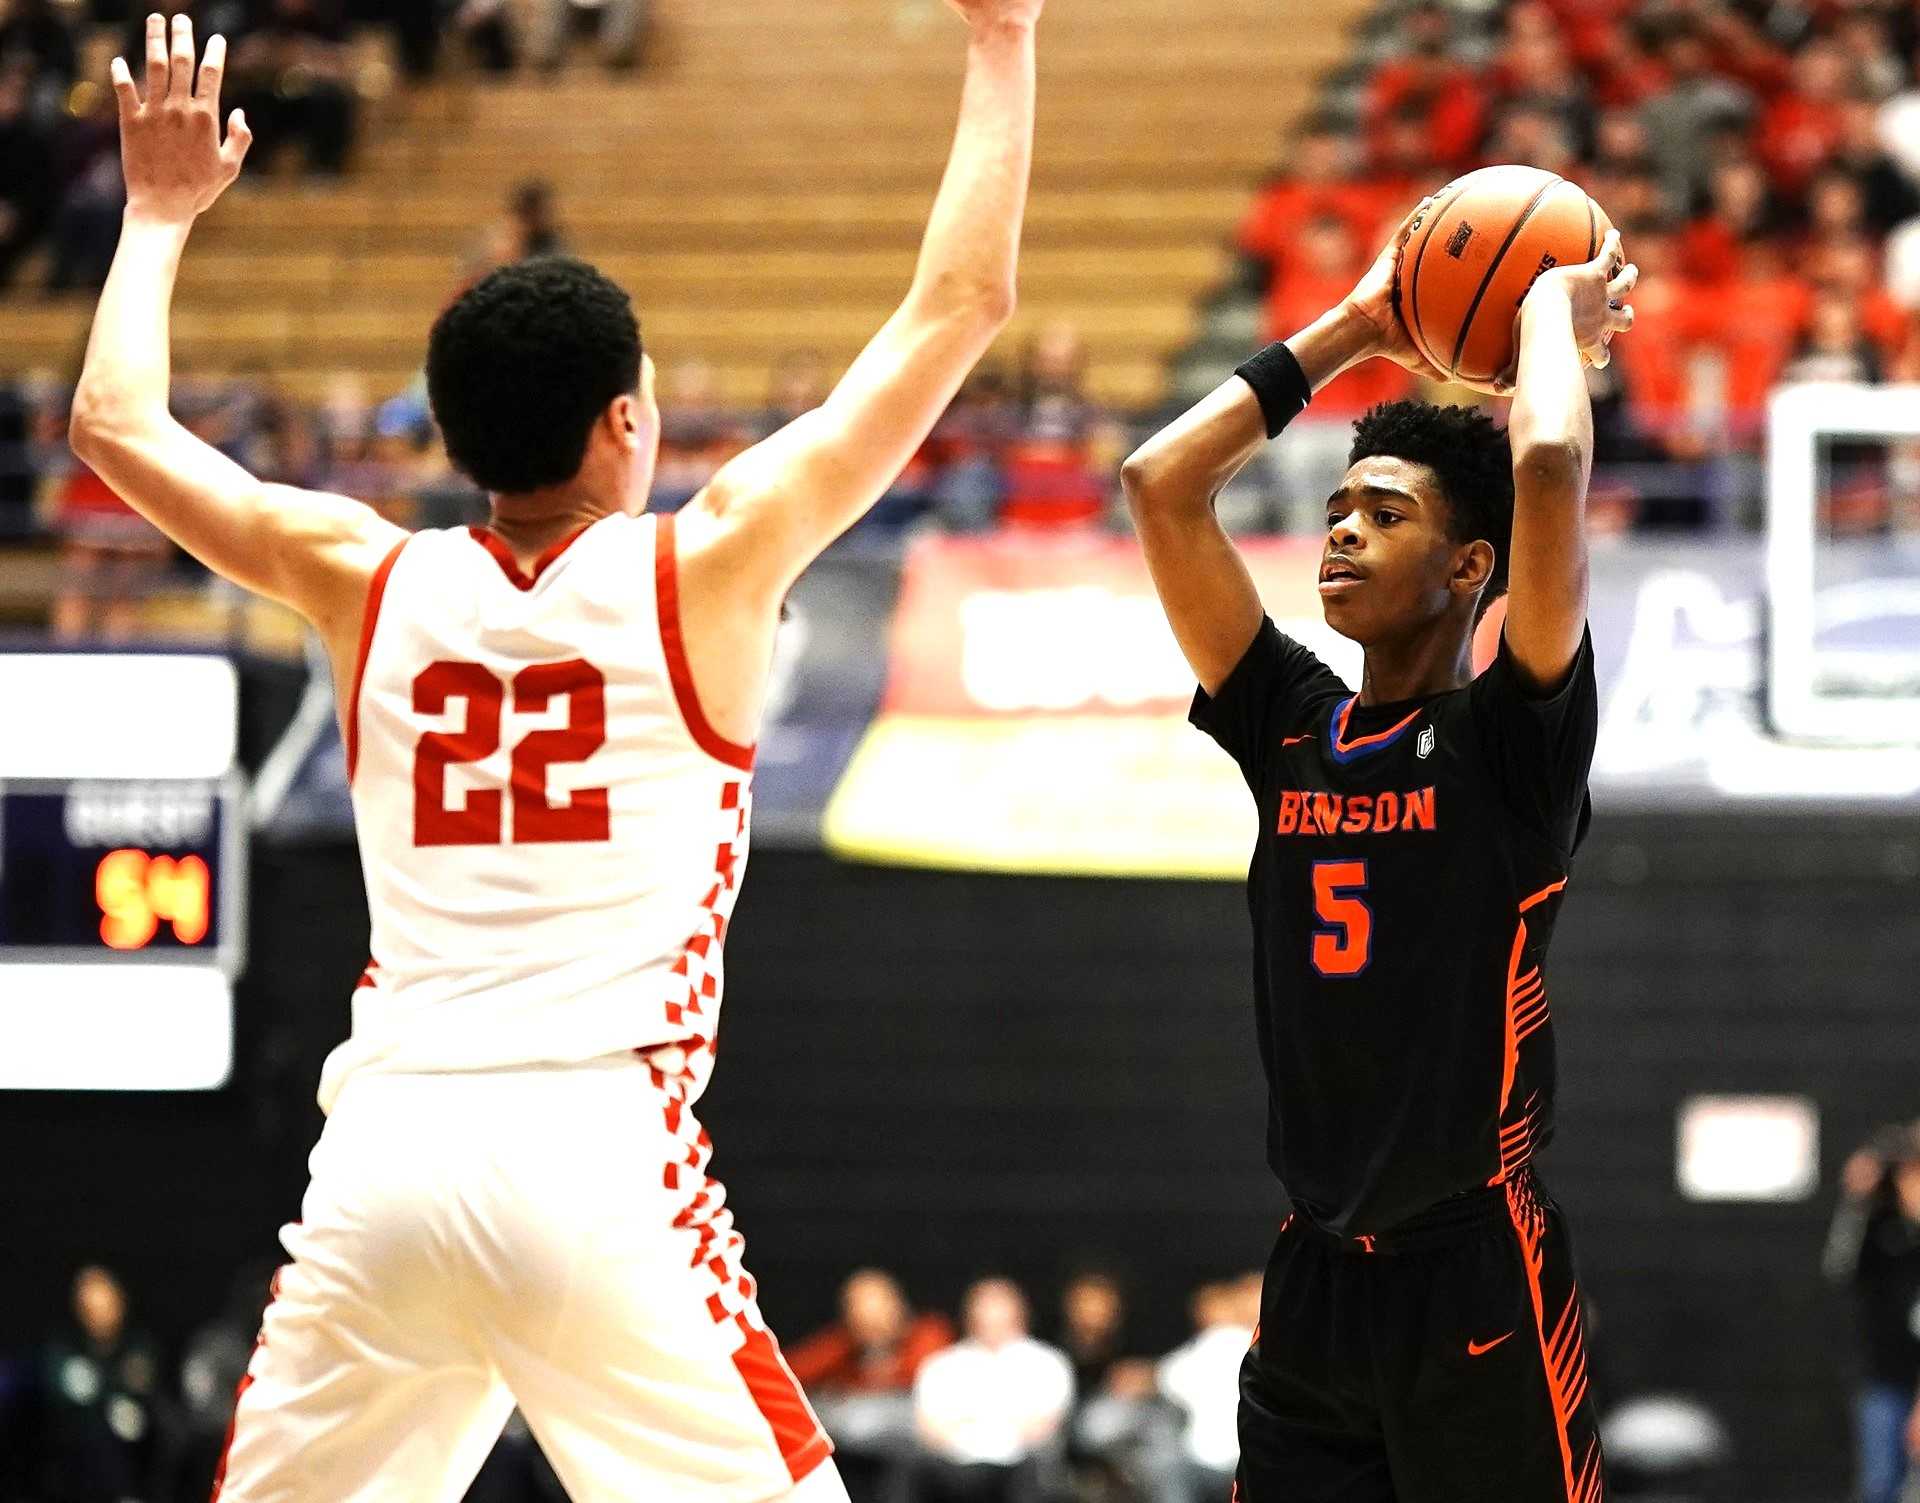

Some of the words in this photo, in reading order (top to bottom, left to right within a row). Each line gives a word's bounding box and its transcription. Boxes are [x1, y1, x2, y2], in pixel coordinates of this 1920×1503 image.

[412, 658, 610, 846] 22
[1277, 785, 1437, 836] BENSON
[96, 849, 210, 950] 54
[1311, 858, 1374, 979] 5
